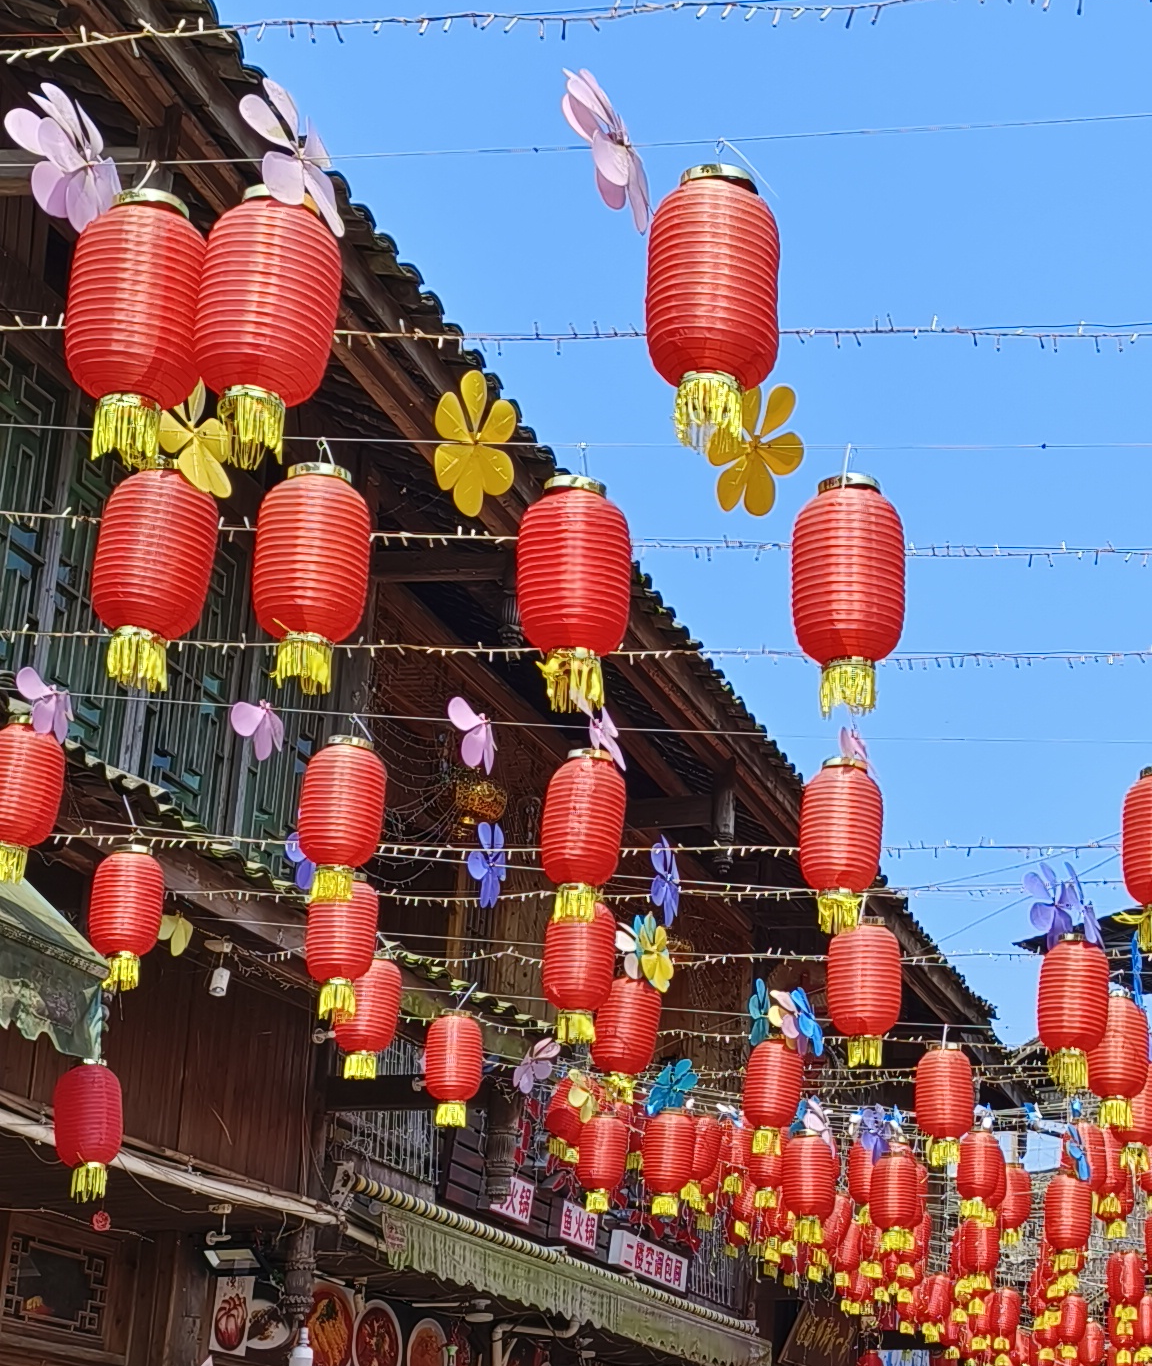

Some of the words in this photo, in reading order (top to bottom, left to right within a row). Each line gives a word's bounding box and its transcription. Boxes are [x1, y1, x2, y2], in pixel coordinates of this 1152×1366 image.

[500, 1182, 532, 1220] 火锅
[562, 1205, 596, 1247] 鱼火锅
